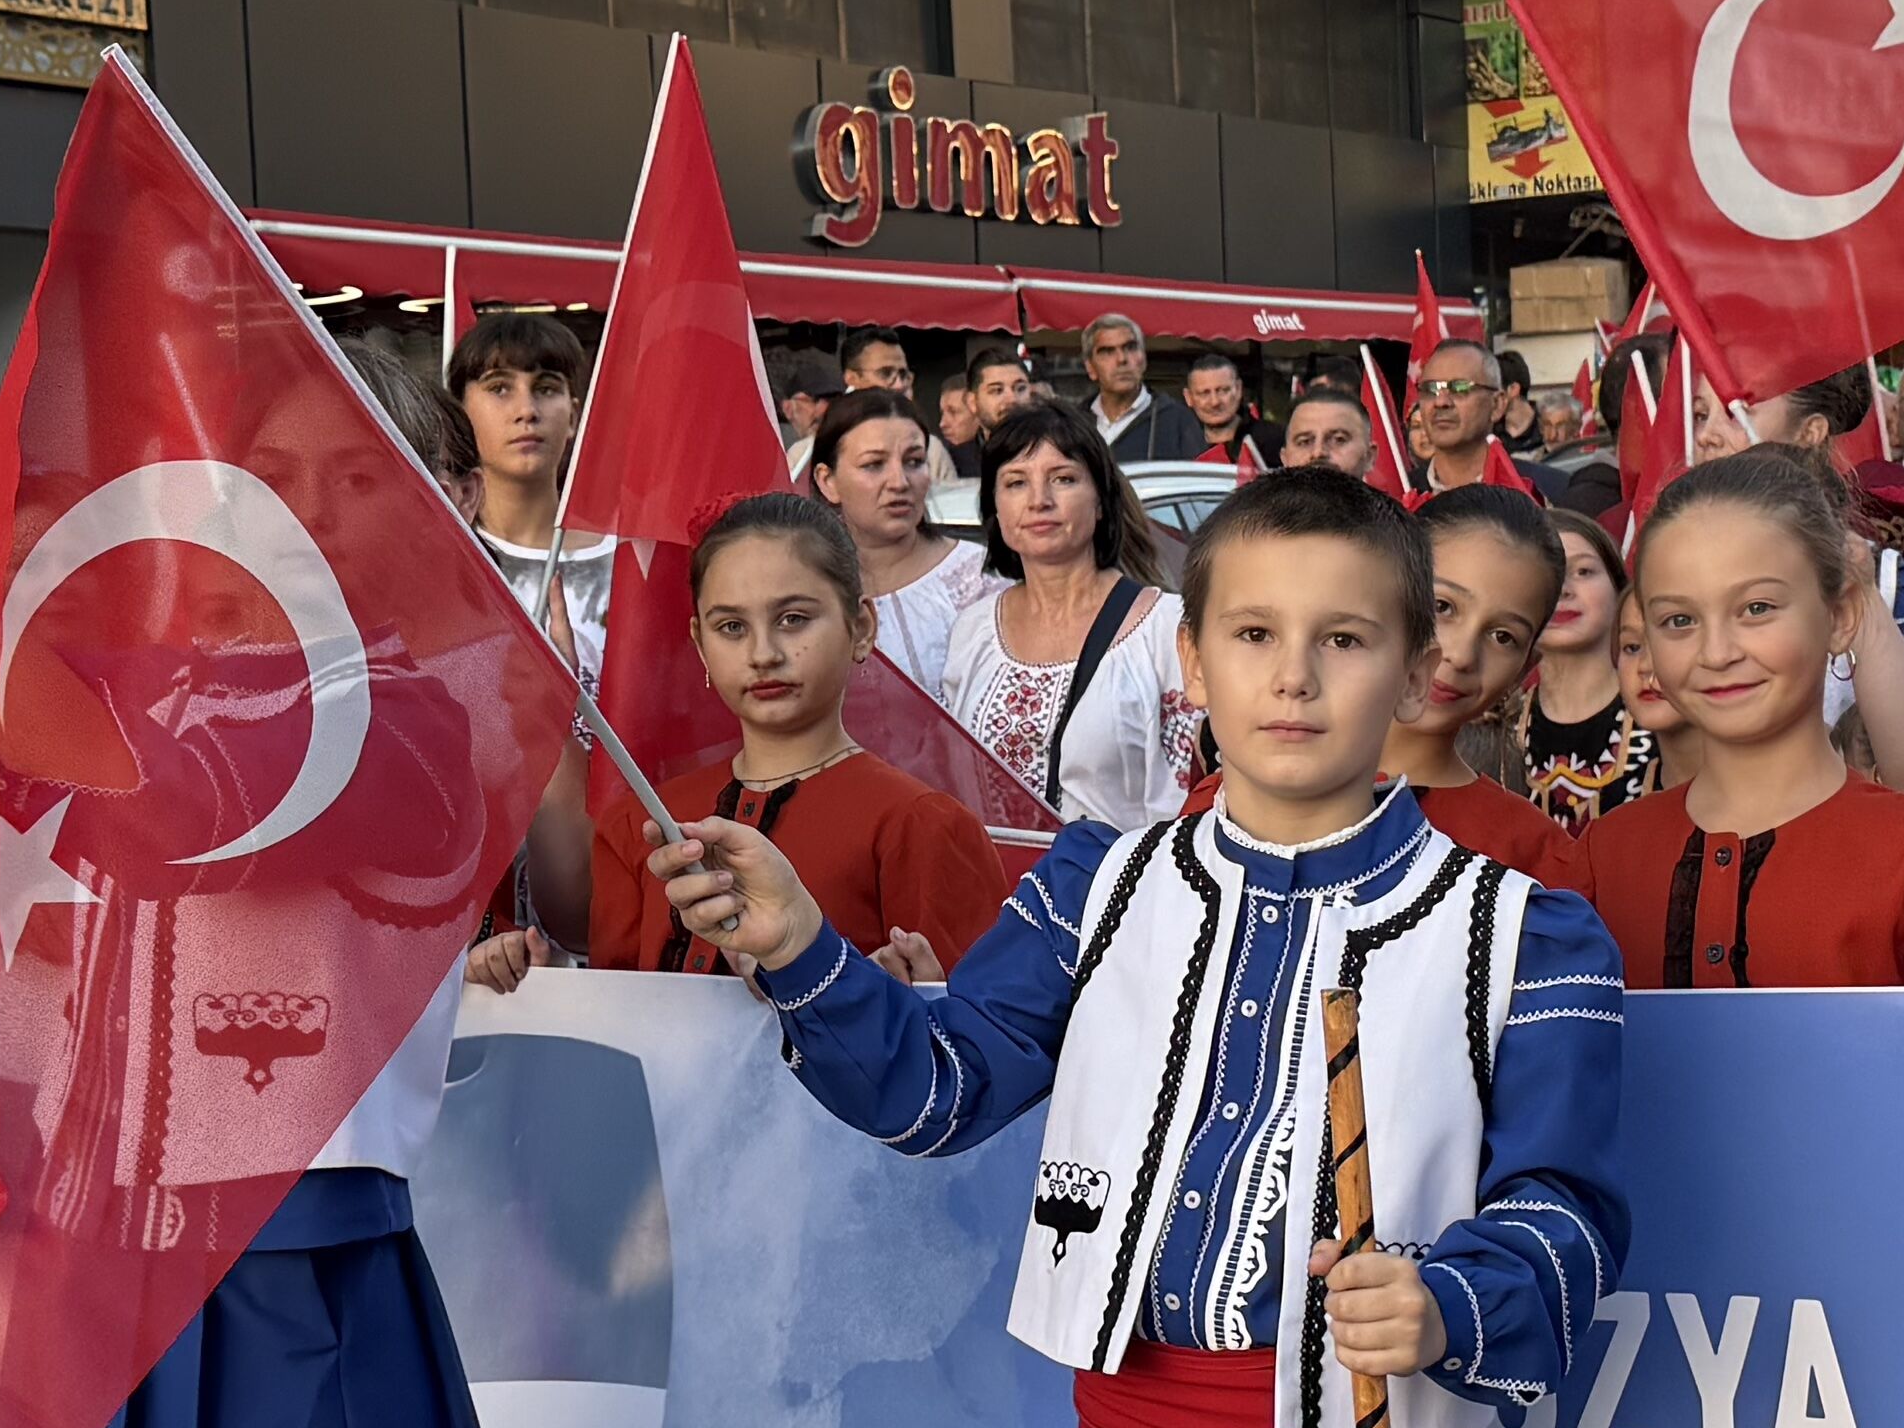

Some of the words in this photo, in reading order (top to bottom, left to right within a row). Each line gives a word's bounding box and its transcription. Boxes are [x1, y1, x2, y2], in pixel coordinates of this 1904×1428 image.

[814, 65, 1123, 248] gimat
[1533, 174, 1597, 192] Noktası
[1252, 308, 1305, 335] gimat
